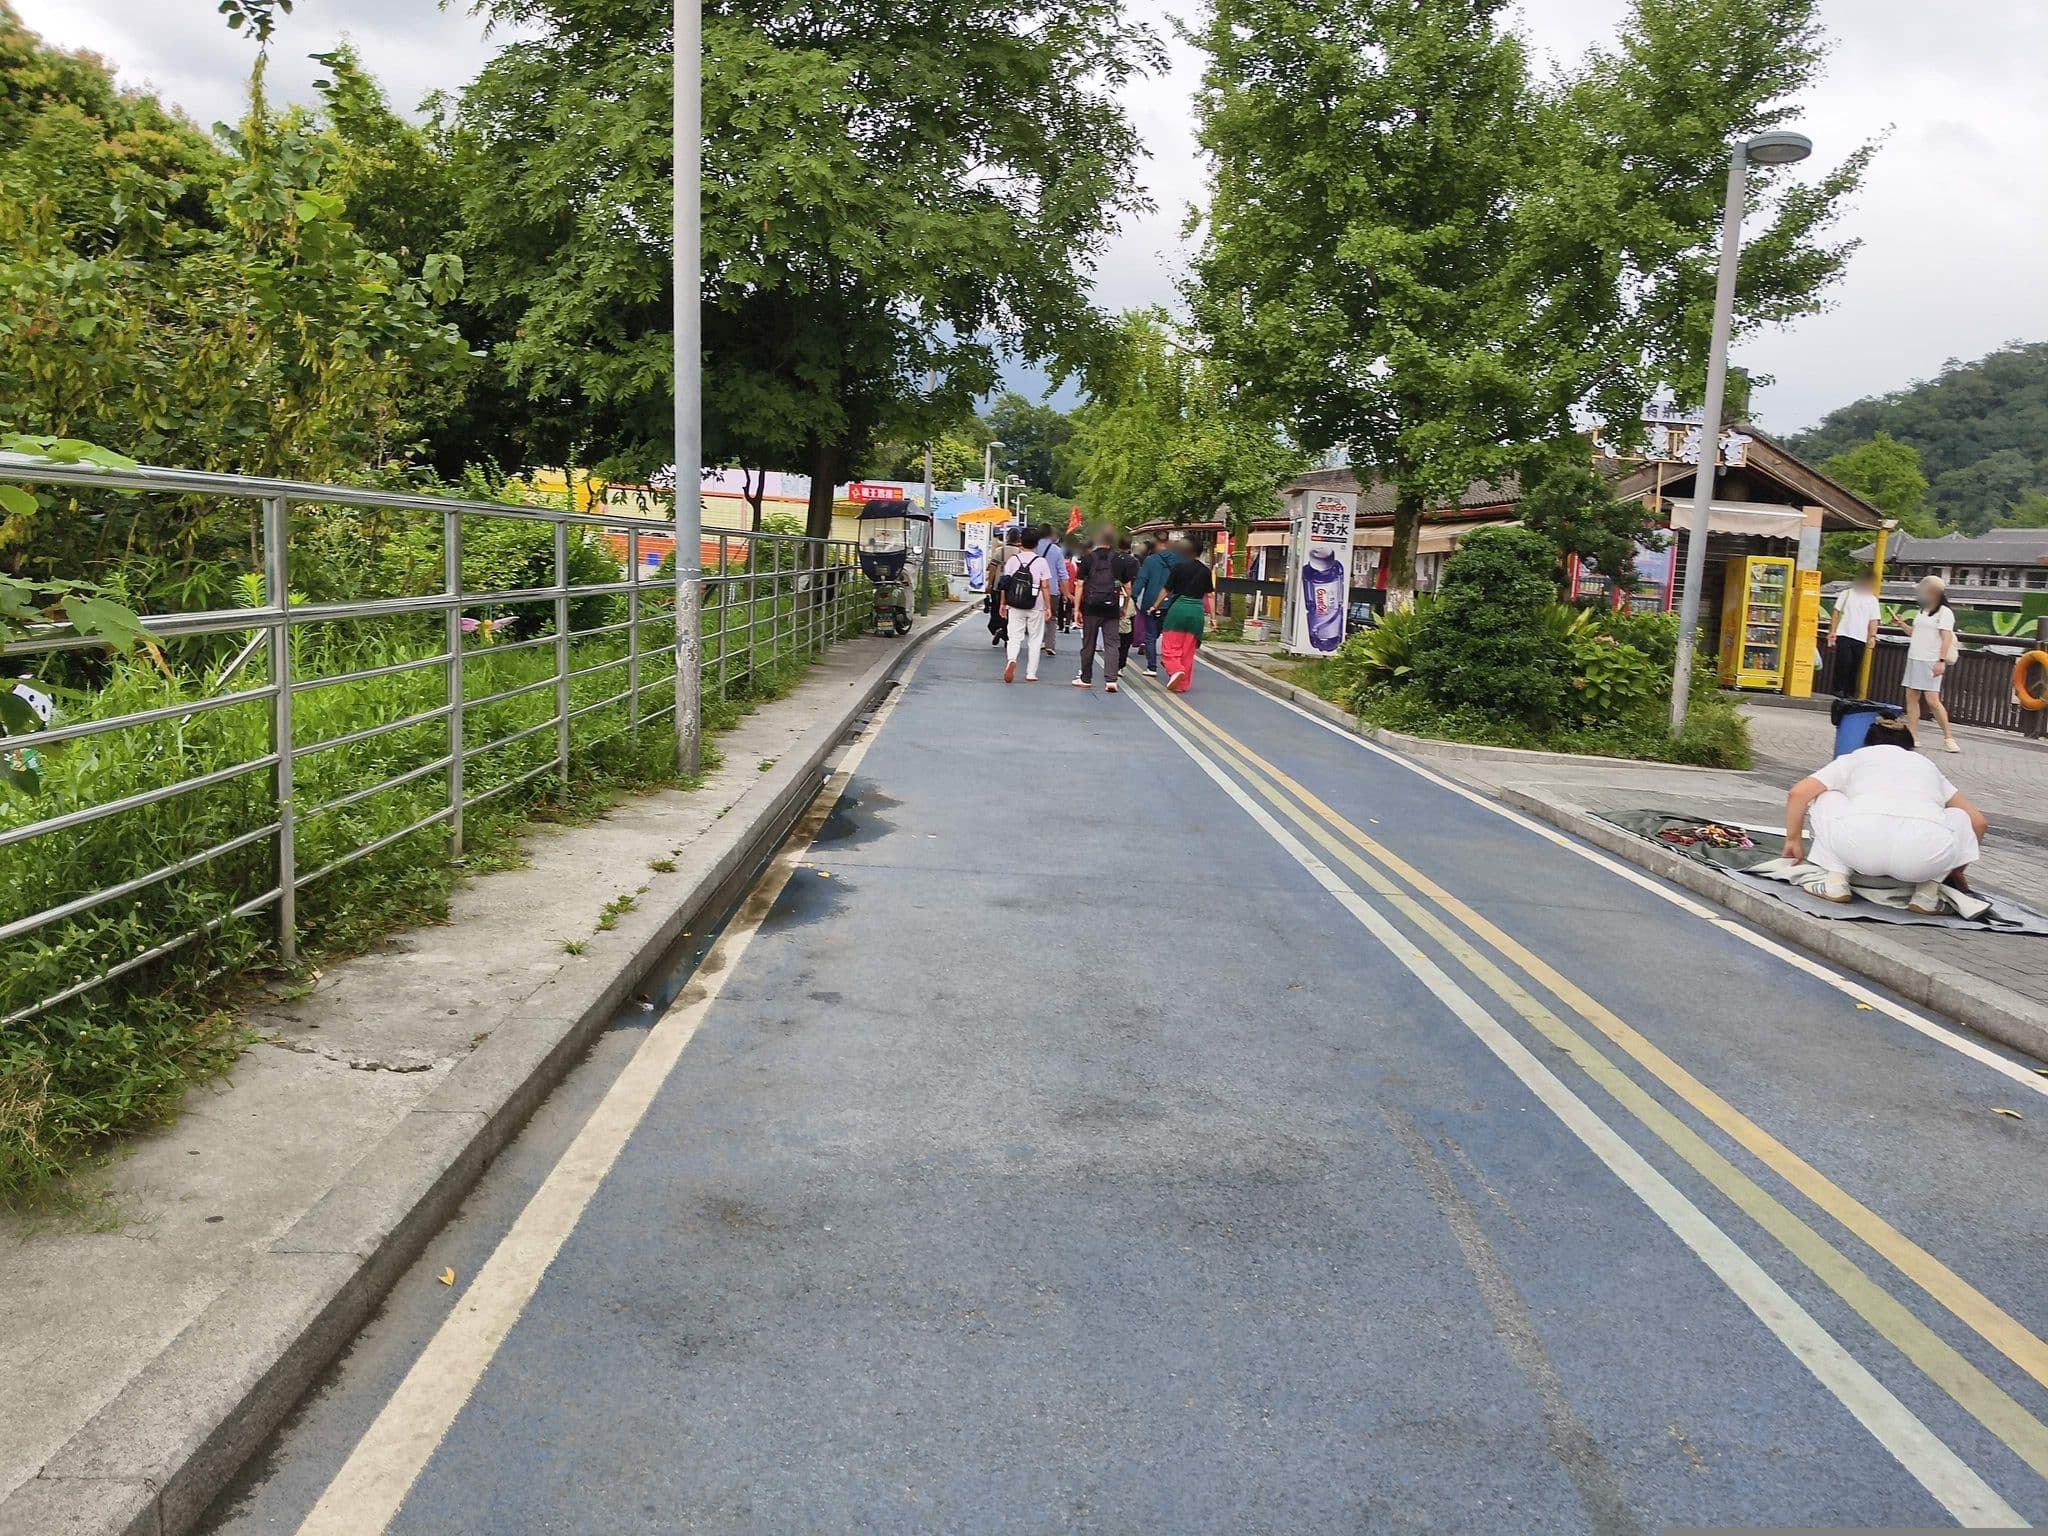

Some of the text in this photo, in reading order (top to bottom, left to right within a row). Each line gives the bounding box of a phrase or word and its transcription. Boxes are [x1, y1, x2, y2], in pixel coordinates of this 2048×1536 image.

[1312, 511, 1350, 523] 真正天然
[1311, 521, 1349, 536] 矿泉水
